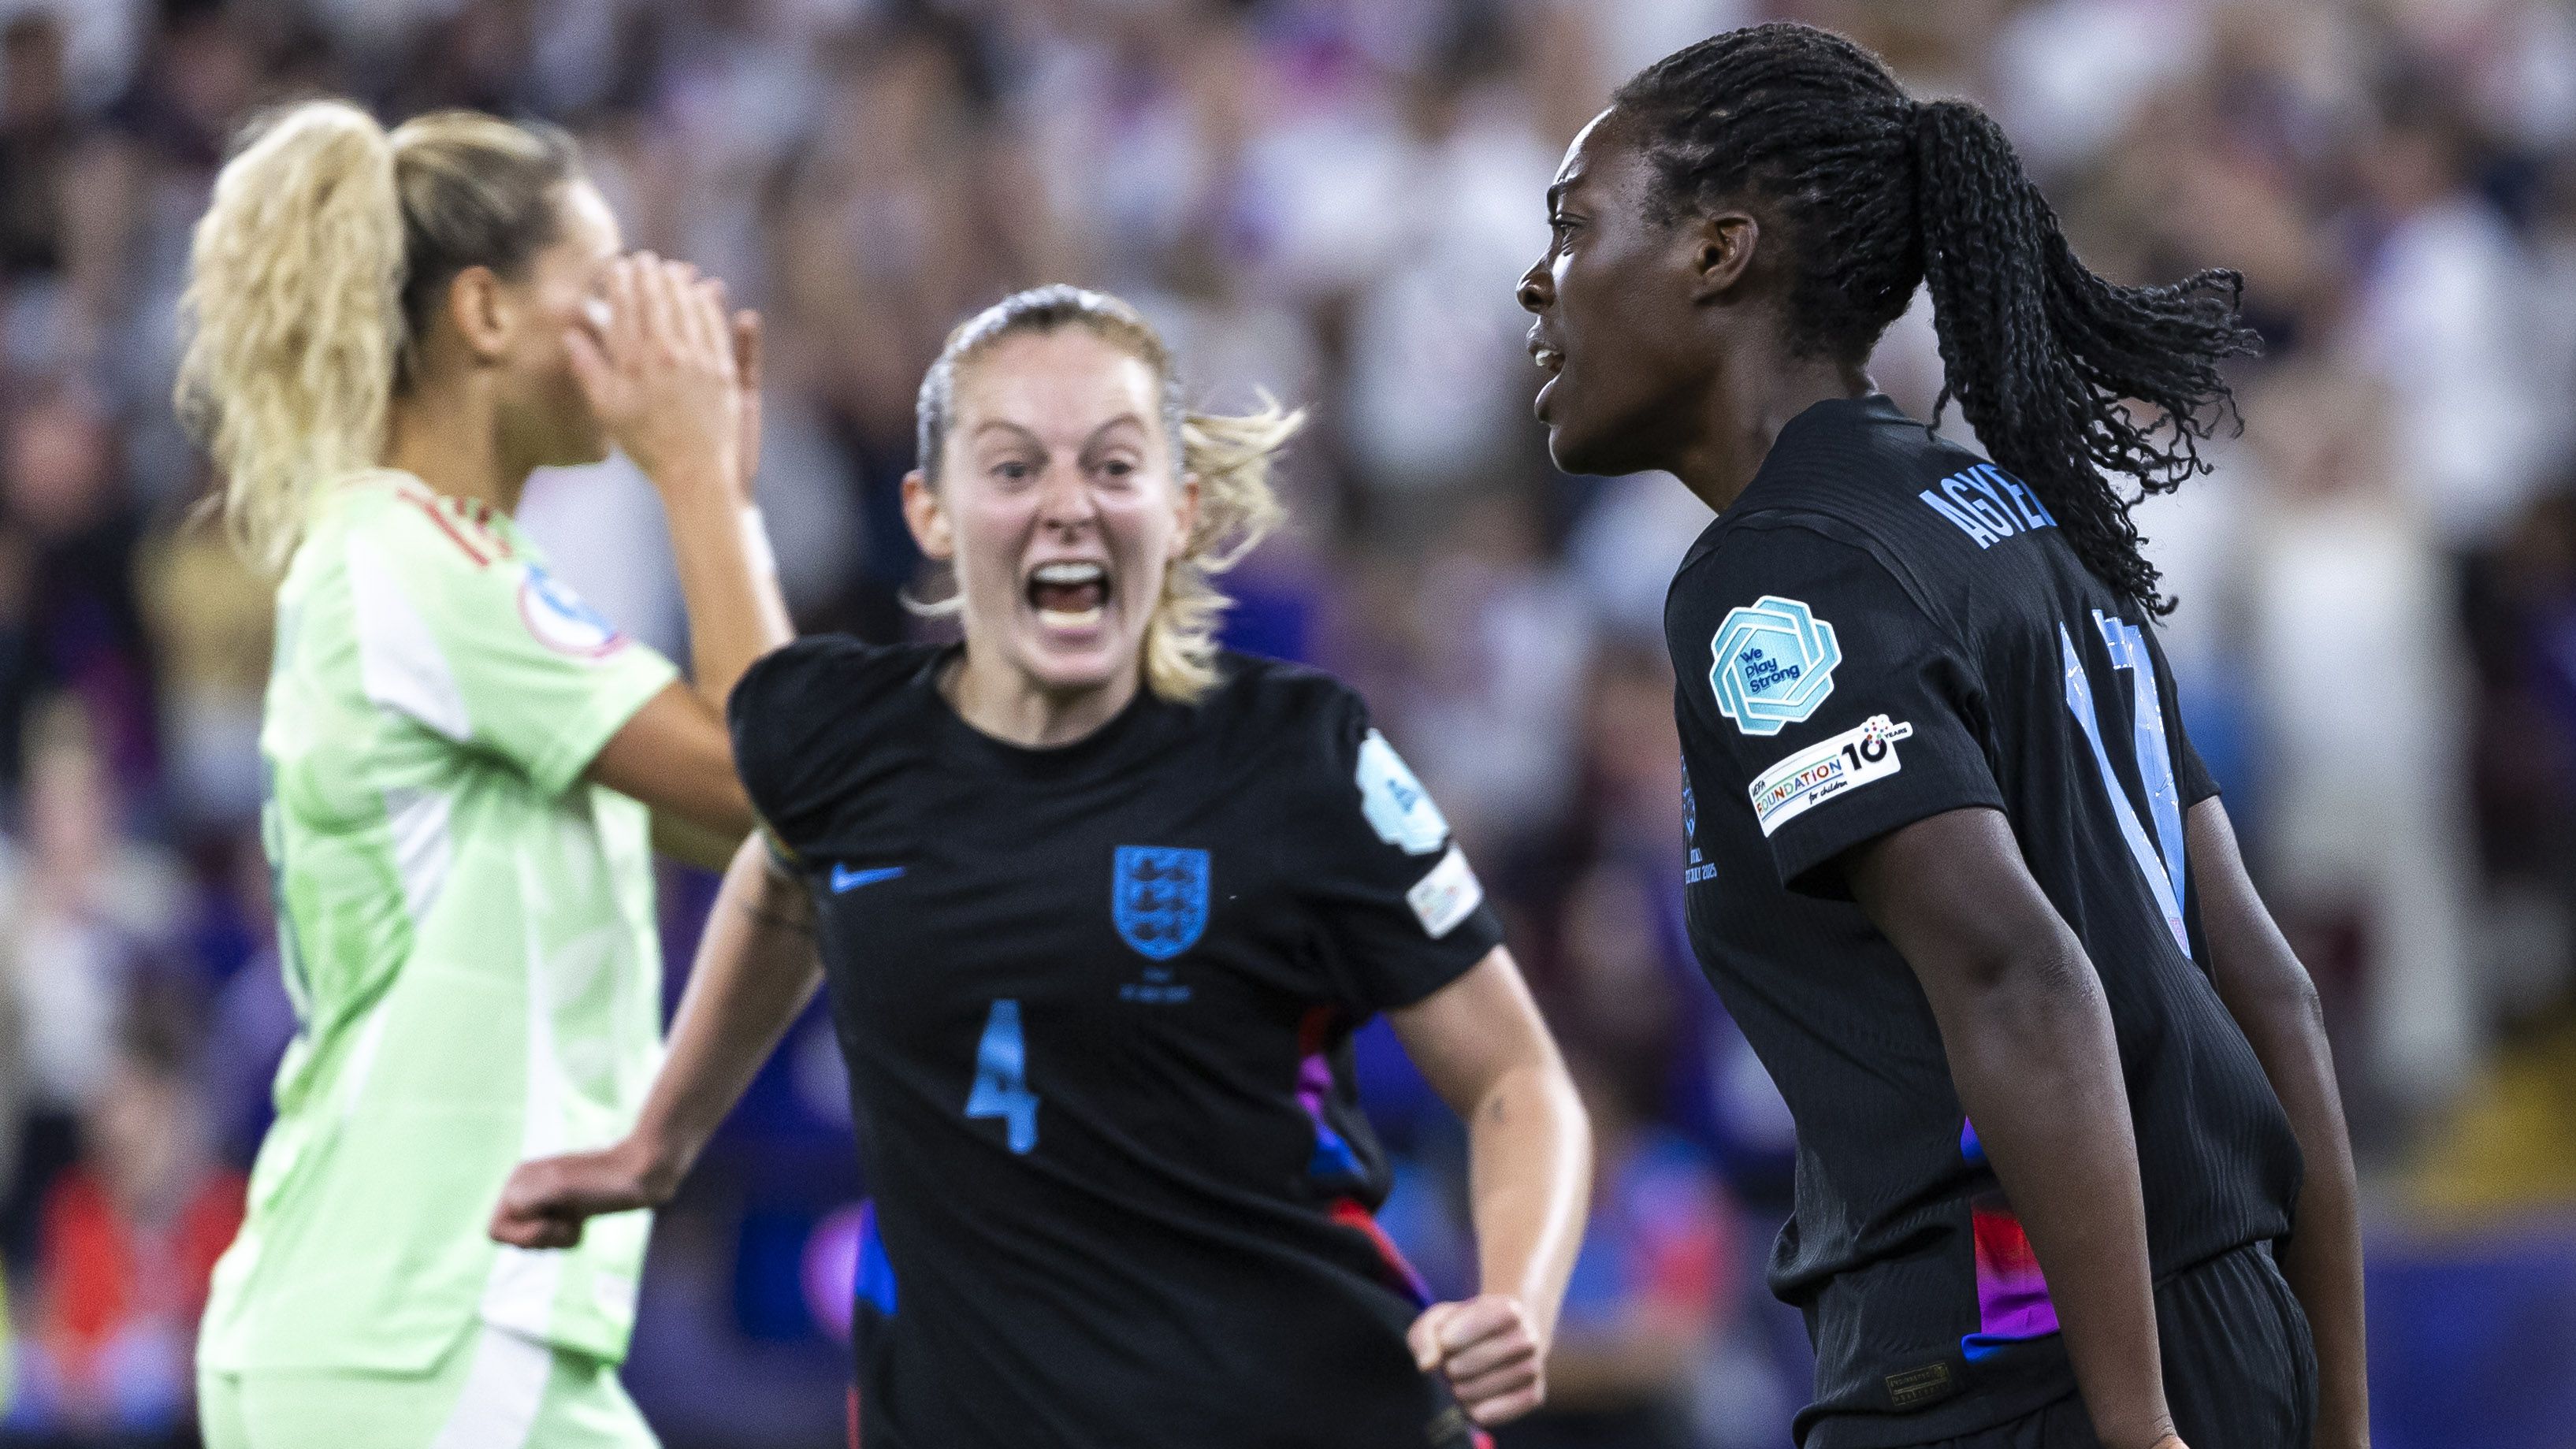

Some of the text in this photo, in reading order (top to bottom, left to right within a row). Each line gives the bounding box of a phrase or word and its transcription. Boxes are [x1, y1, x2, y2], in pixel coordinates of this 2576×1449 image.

[1739, 648, 1763, 663] We
[1745, 657, 1778, 679] Play
[1749, 664, 1801, 693] Strong
[1883, 726, 1908, 739] YEARS
[1841, 737, 1888, 771] 10
[1756, 758, 1842, 817] FOUNDATION
[1808, 780, 1848, 805] for children
[2058, 608, 2192, 960] 17
[965, 998, 1040, 1156] 4
